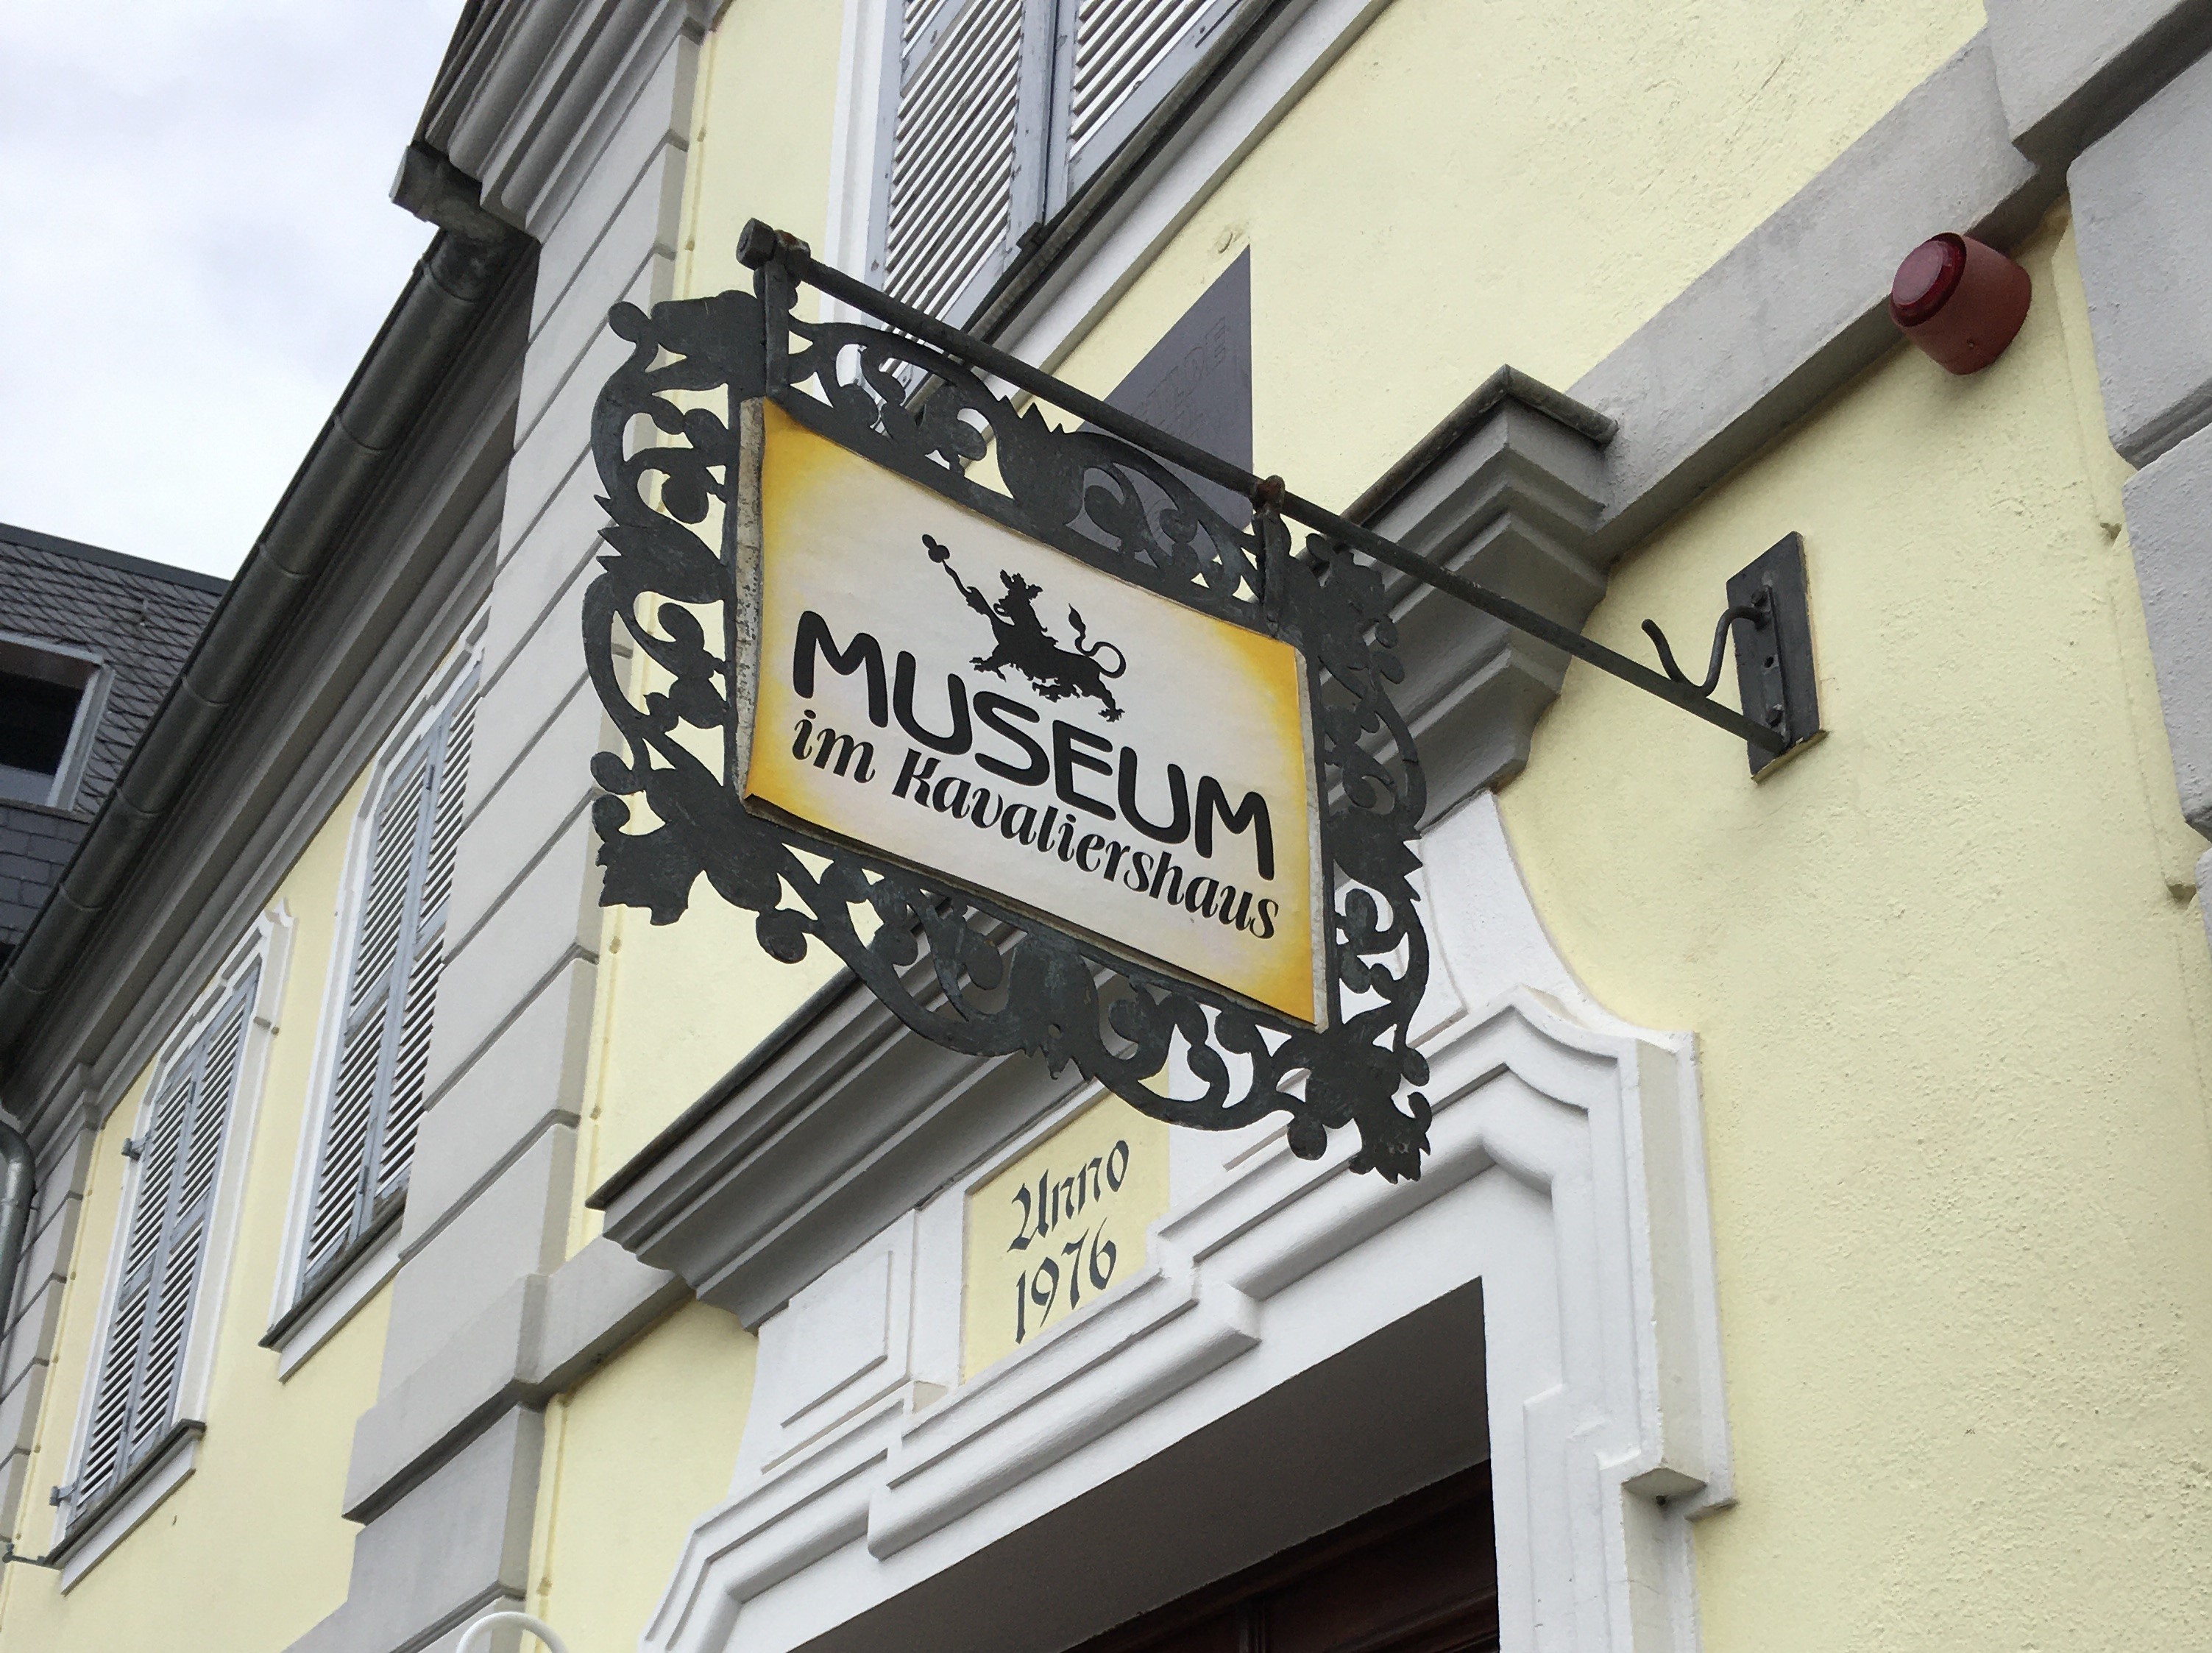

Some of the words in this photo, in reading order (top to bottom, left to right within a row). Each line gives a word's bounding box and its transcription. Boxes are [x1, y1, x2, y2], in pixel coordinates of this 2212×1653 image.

[792, 709, 876, 783] im
[891, 747, 1279, 939] Kavaliershaus
[793, 610, 1275, 881] MUSEUM
[1007, 1139, 1130, 1253] Anno
[1015, 1217, 1117, 1345] 1976
